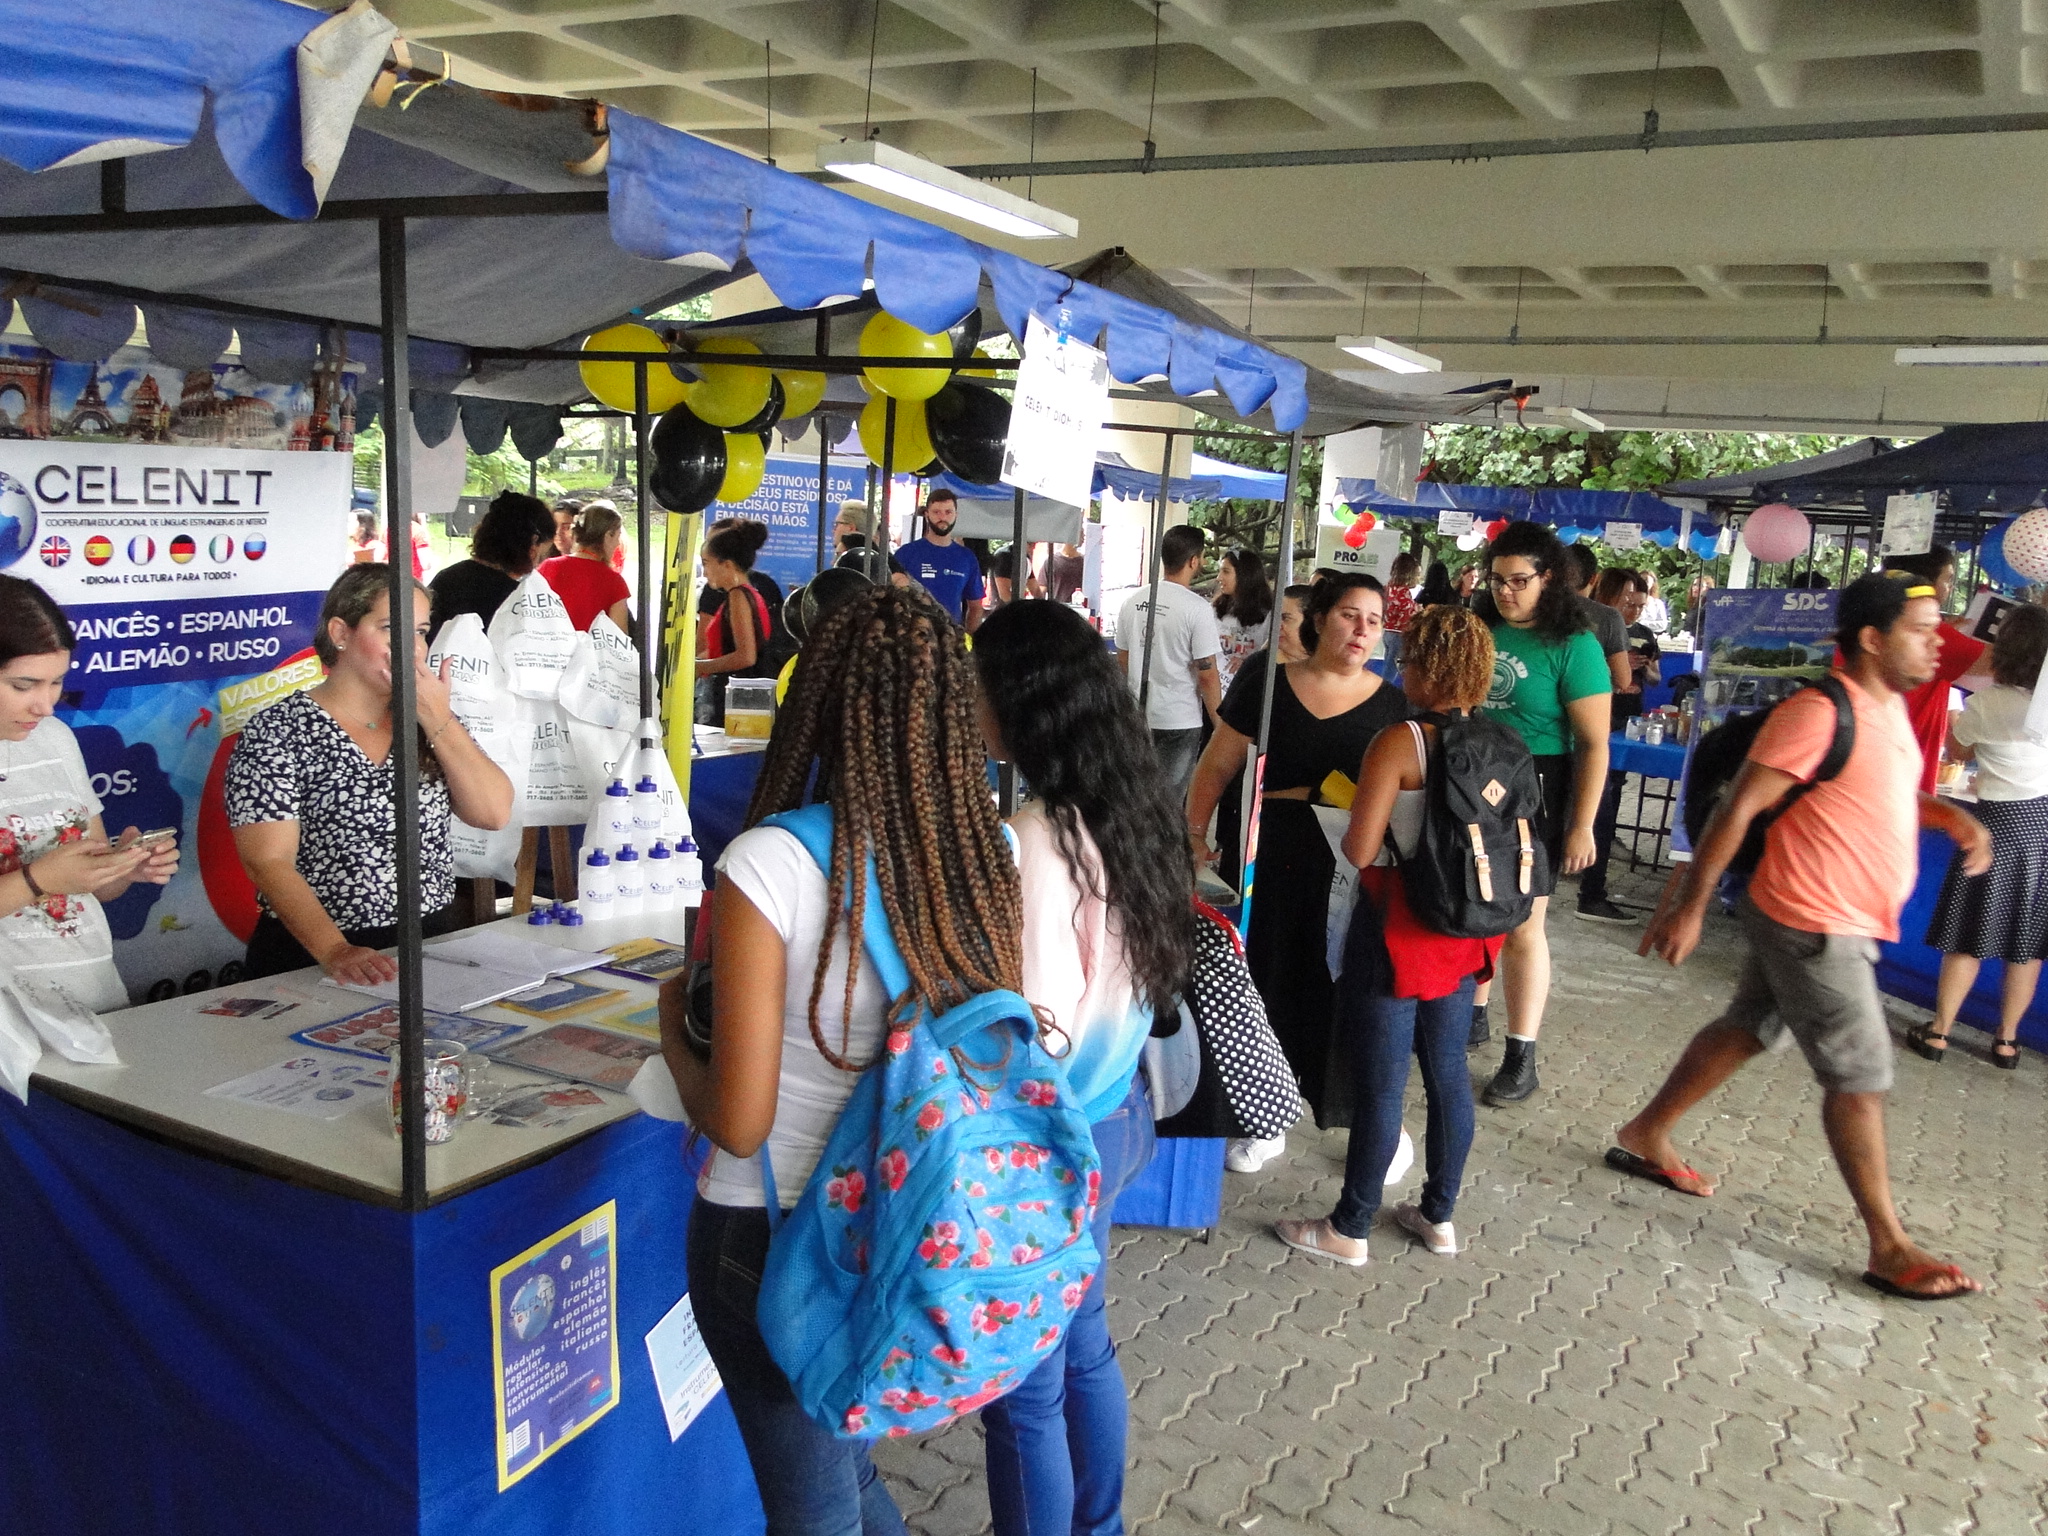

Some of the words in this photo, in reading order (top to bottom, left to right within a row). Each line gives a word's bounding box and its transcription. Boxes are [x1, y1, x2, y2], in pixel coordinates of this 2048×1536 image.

[35, 464, 273, 506] CELENIT
[785, 488, 848, 503] RESÍDOS?
[804, 476, 837, 491] VOÊ
[837, 478, 853, 491] DÁ
[728, 497, 779, 512] DECISÃO
[782, 502, 810, 515] ESTÁ
[772, 512, 810, 527] MÃOS.
[86, 575, 121, 585] IDIOMA
[123, 574, 129, 584] E
[131, 573, 173, 584] CULTURA
[176, 572, 200, 582] PARA
[203, 571, 232, 580] TODOS
[1782, 592, 1830, 611] SDC
[180, 606, 293, 635] ESPANHOL
[85, 642, 190, 674] ALEMÃO
[208, 637, 280, 664] RUSSO
[222, 658, 319, 708] VALORES
[570, 1265, 606, 1291] inglês
[553, 1288, 607, 1329] espanhol
[562, 1278, 606, 1310] francês
[561, 1317, 608, 1351] italiano
[563, 1305, 607, 1336] alemão
[575, 1330, 608, 1355] russo
[505, 1344, 546, 1378] Módulos
[506, 1356, 542, 1388] regular
[507, 1360, 567, 1408] conversação
[508, 1365, 569, 1418] Instrumental
